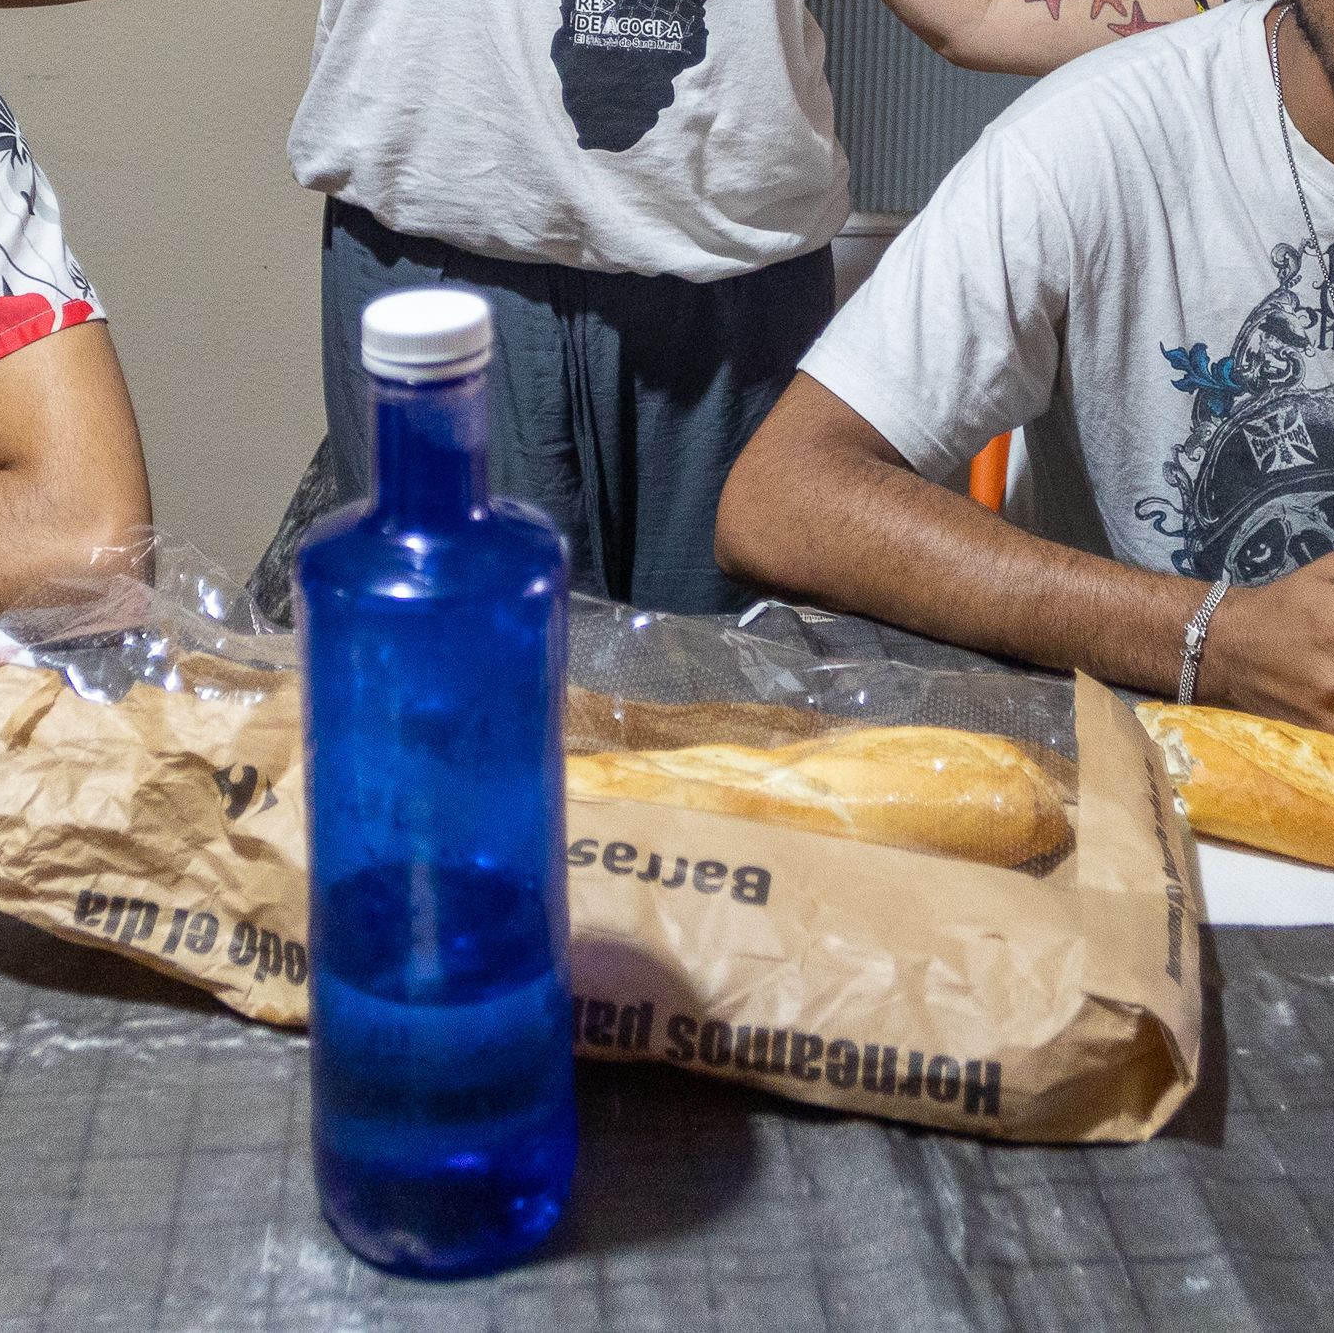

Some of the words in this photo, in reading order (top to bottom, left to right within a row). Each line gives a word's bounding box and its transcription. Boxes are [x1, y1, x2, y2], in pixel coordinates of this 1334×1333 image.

[575, 14, 602, 33] DE
[632, 37, 657, 49] Santa
[567, 839, 772, 907] Barras
[161, 908, 219, 954] el
[228, 921, 309, 987] odo
[664, 1014, 1002, 1118] Horneamos
